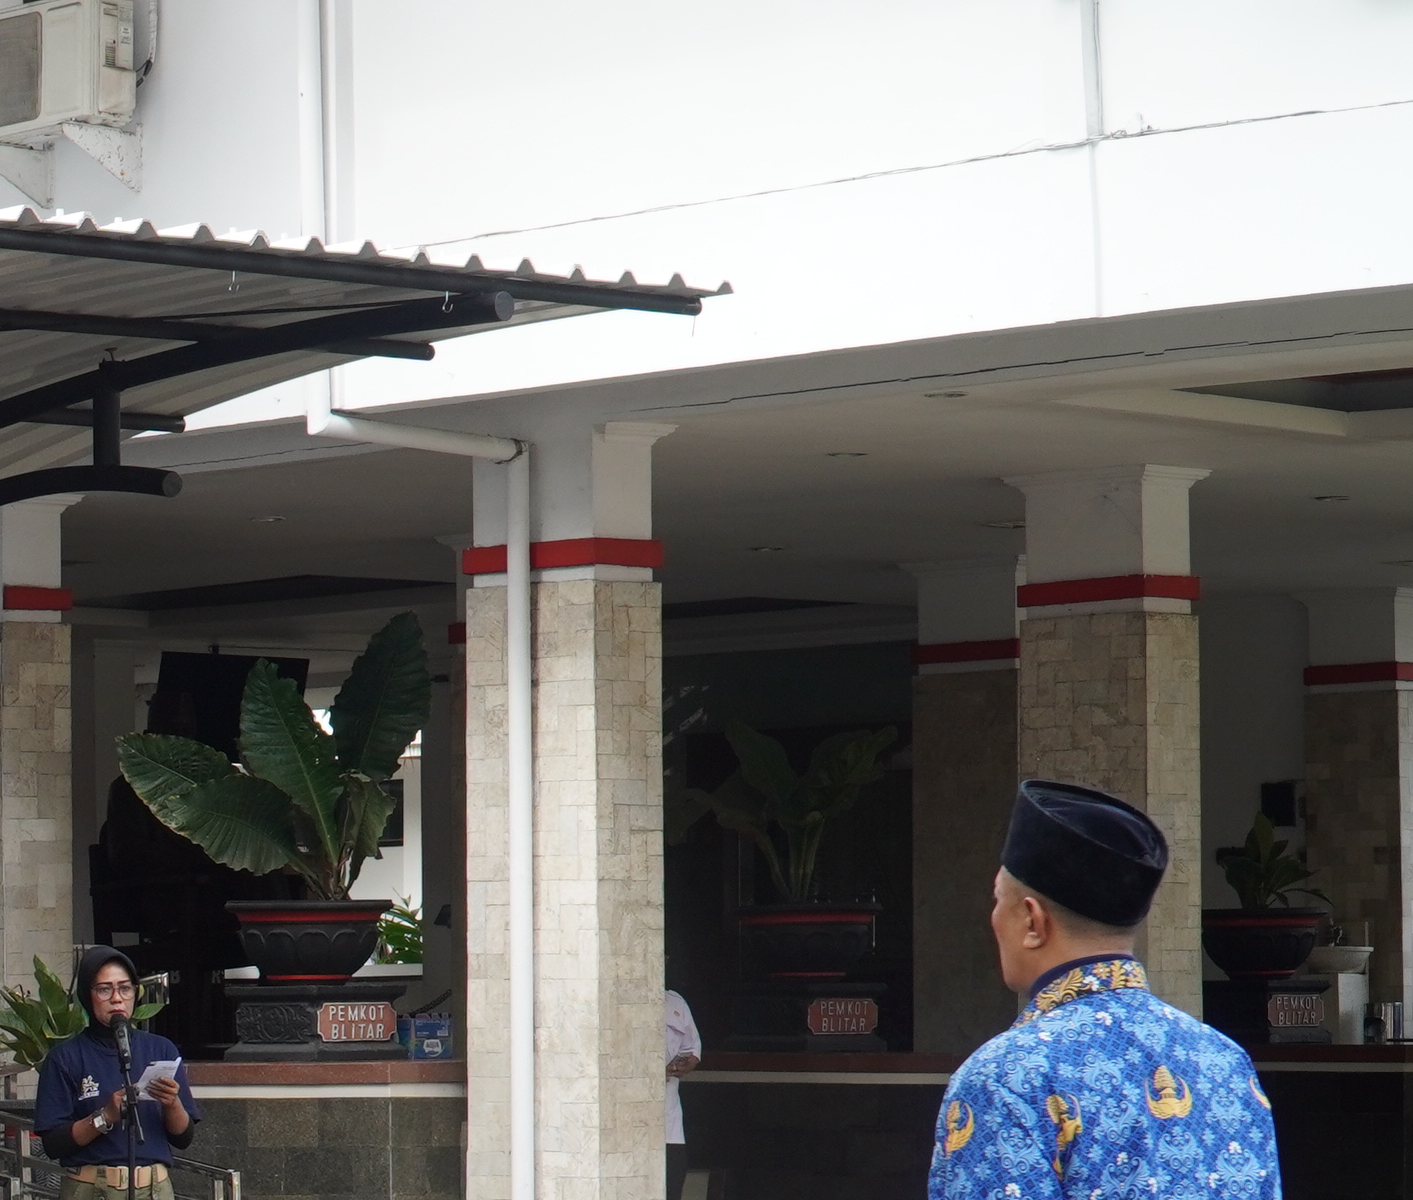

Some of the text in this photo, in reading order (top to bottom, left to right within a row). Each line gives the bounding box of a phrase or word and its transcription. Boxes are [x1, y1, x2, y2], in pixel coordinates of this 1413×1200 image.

[820, 1001, 869, 1015] PEMKOT
[1276, 996, 1317, 1010] PEMKOT
[329, 1005, 385, 1021] PEMKOT
[1278, 1011, 1316, 1025] BLITAR
[331, 1023, 385, 1039] BLITAR
[822, 1018, 866, 1032] BLITAR
